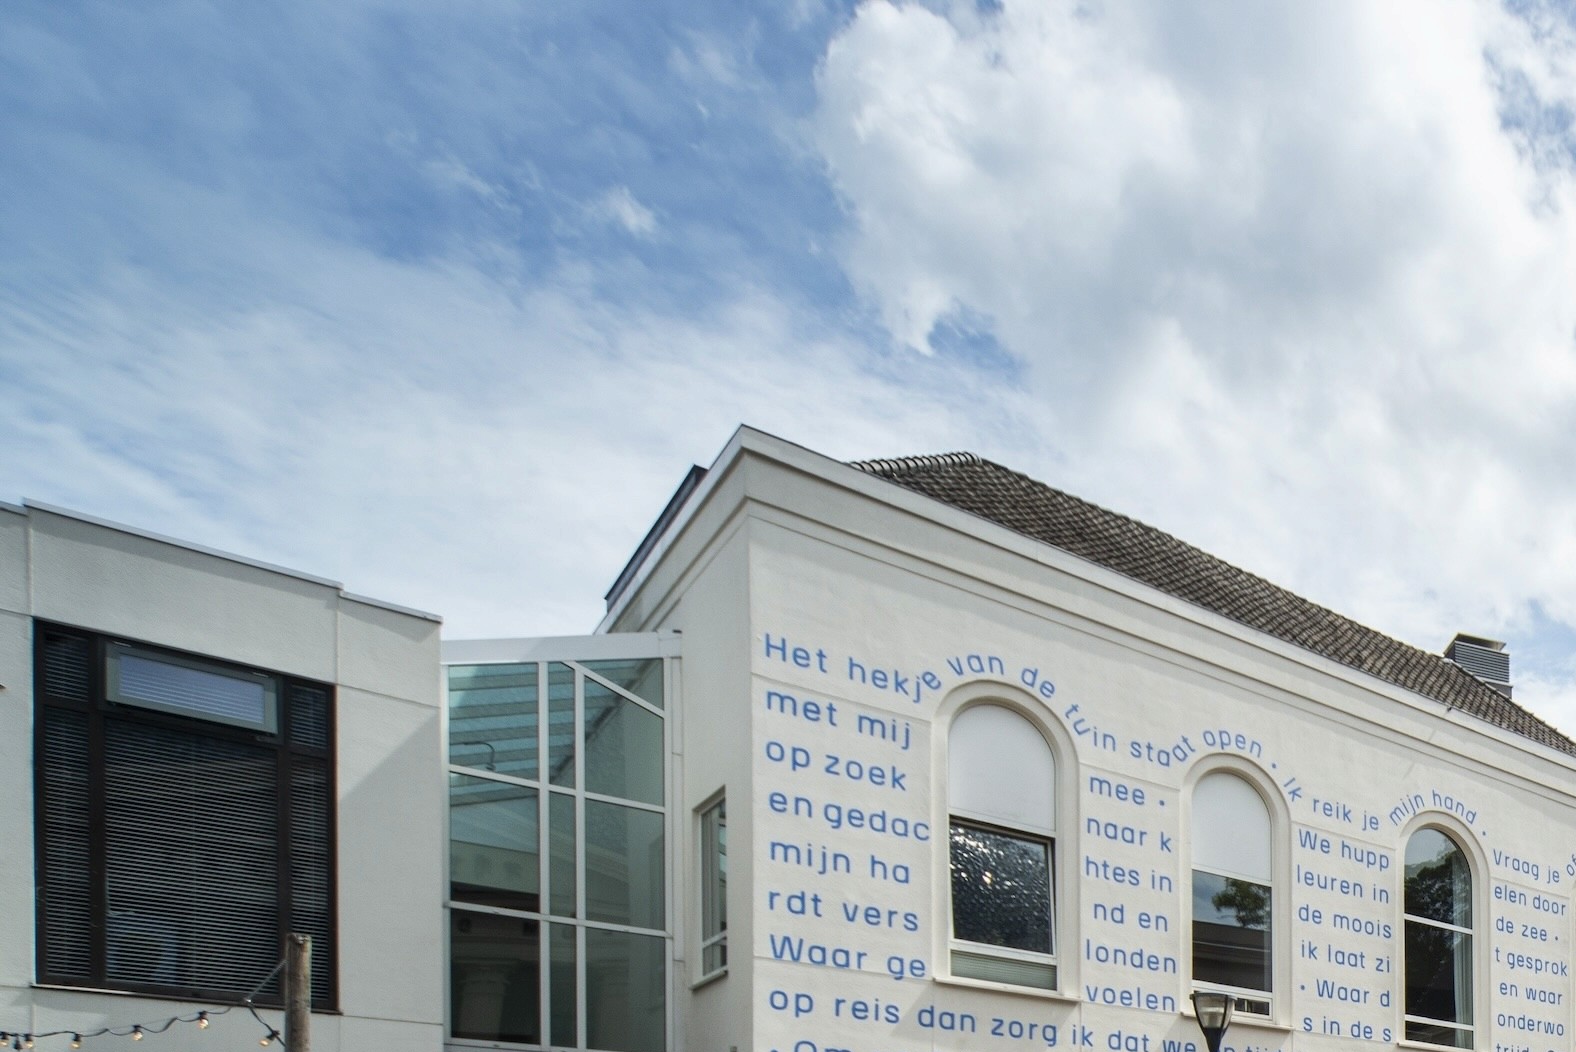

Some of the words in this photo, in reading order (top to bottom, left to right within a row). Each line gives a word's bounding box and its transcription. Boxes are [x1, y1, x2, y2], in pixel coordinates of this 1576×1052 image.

[765, 633, 827, 673] Het
[848, 657, 941, 703] hekje
[947, 654, 1004, 676] van
[1020, 668, 1056, 698] de
[1065, 704, 1117, 752] tuin
[1130, 736, 1196, 767] staat
[1203, 730, 1262, 758] open
[1284, 777, 1302, 802] Ik
[1313, 799, 1351, 823] reik
[1362, 814, 1379, 831] je
[1389, 794, 1424, 824] mijn
[1432, 789, 1477, 824] hand
[1493, 849, 1539, 880] Vraag
[1547, 869, 1560, 884] je
[765, 741, 811, 771] op
[824, 755, 906, 791] zoek
[1087, 818, 1147, 846] naar
[1160, 832, 1171, 852] k
[1297, 864, 1363, 898] leuren
[1373, 888, 1389, 904] in
[1496, 916, 1514, 934] de
[1522, 924, 1547, 941] zee
[767, 691, 837, 726] met
[857, 714, 910, 751] mij
[1090, 777, 1145, 805] mee
[1299, 830, 1331, 854] We
[1341, 840, 1389, 871] hupp
[1495, 885, 1526, 905] elen
[1533, 895, 1566, 916] door
[768, 792, 812, 818] en
[823, 803, 929, 841] gedac
[1086, 856, 1140, 886] htes
[1151, 870, 1172, 893] in
[1299, 904, 1322, 924] de
[1333, 914, 1392, 939] moois
[1495, 947, 1500, 962] t
[1507, 953, 1567, 976] gesprok
[768, 891, 822, 917] rdt
[843, 903, 918, 932] vers
[1086, 939, 1176, 974] londen
[1317, 979, 1369, 1003] Waar
[1380, 991, 1390, 1007] d
[1498, 1014, 1564, 1036] onderwo
[770, 841, 851, 875] mijn
[870, 855, 910, 884] ha
[1094, 904, 1125, 924] nd
[1138, 912, 1168, 932] en
[1302, 941, 1317, 960] ik
[1328, 944, 1365, 968] laat
[1376, 956, 1390, 973] zi
[1500, 982, 1517, 997] en
[1526, 988, 1562, 1005] waar
[769, 990, 814, 1018] op
[834, 998, 899, 1024] reis
[917, 1006, 976, 1032] dan
[991, 1018, 1057, 1047] zorg
[1073, 1026, 1093, 1047] ik
[770, 934, 867, 969] Waar
[887, 956, 926, 981] ge
[1086, 985, 1175, 1012] voelen
[1304, 1017, 1312, 1033] s
[1323, 1016, 1340, 1035] in
[1351, 1021, 1372, 1040] de
[1383, 1028, 1391, 1042] s
